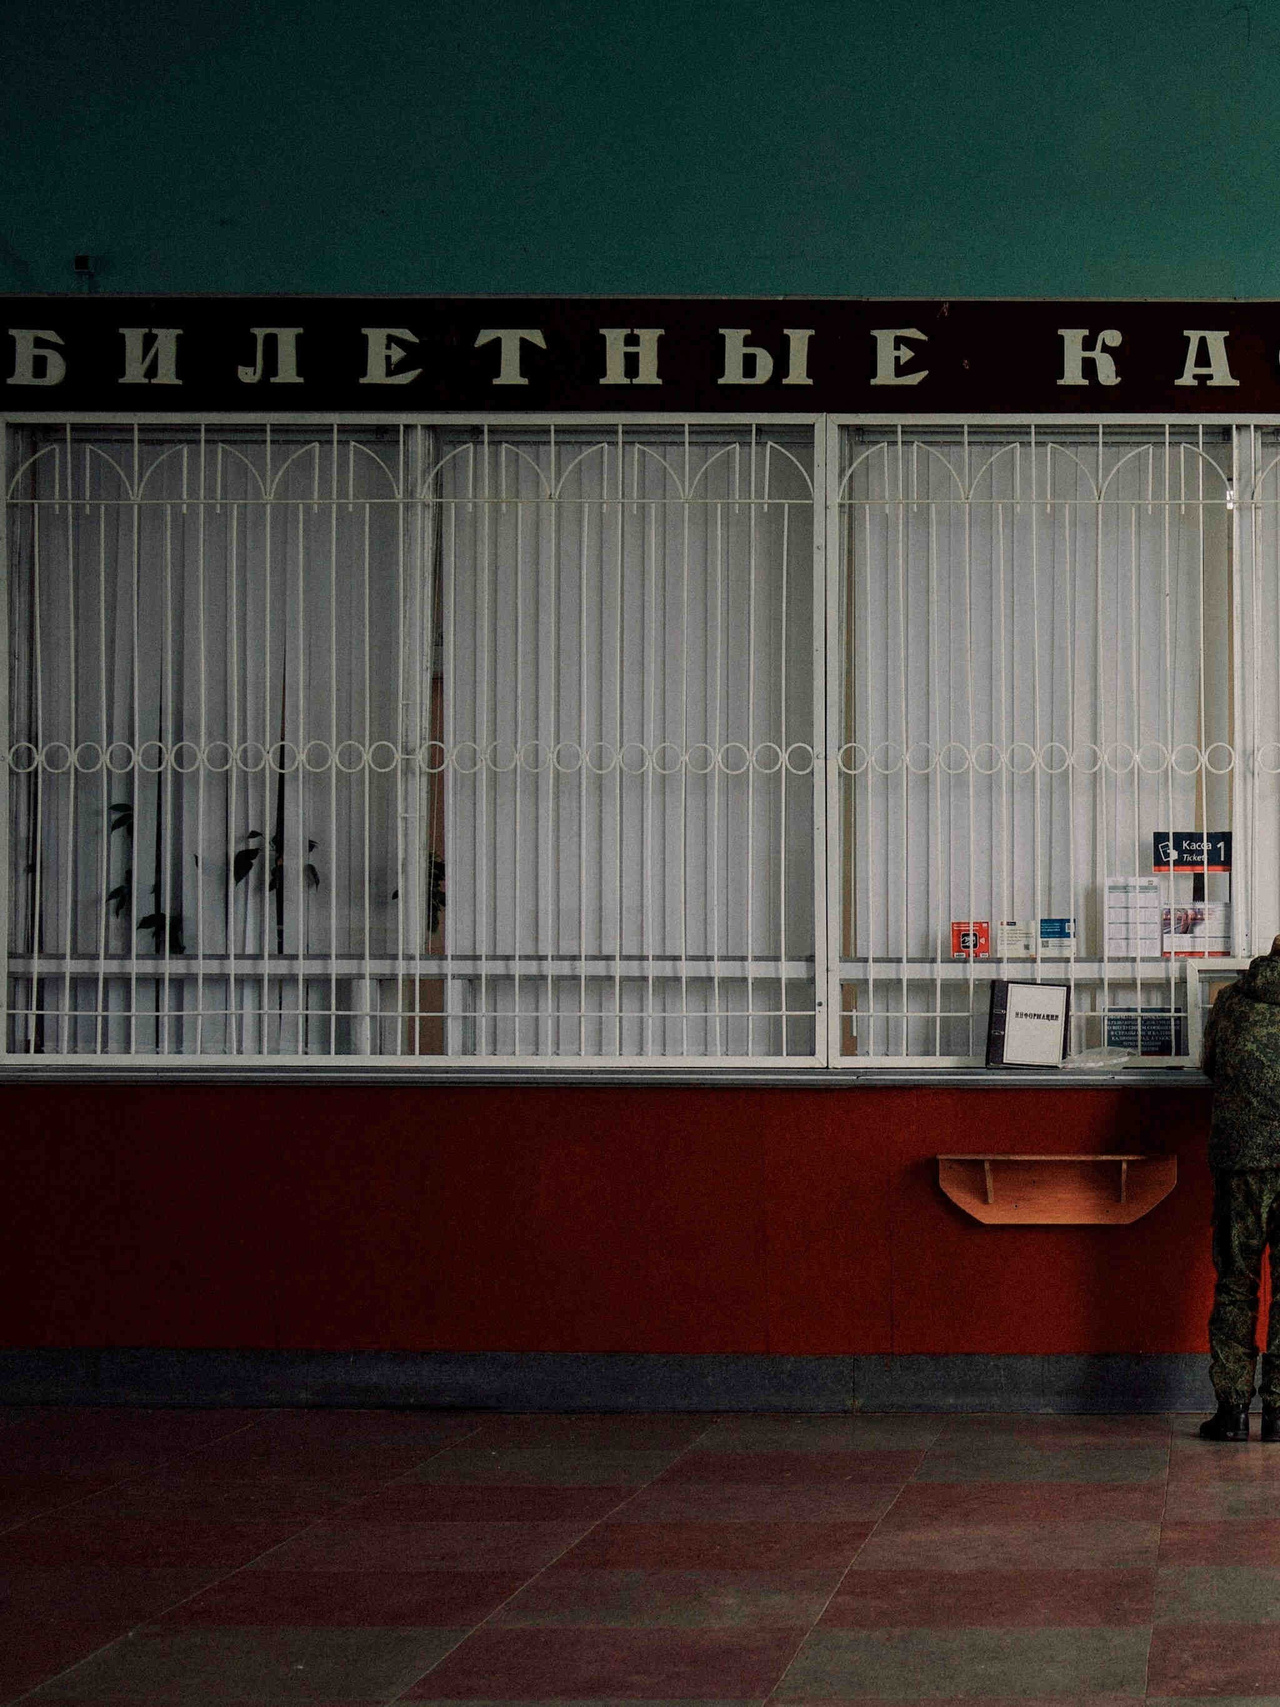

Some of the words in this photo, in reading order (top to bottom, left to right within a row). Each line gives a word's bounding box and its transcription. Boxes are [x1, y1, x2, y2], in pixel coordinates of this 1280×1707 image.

[6, 328, 929, 386] БИЛЕТНЫЕ
[1182, 840, 1212, 850] Касса
[1216, 841, 1225, 861] 1
